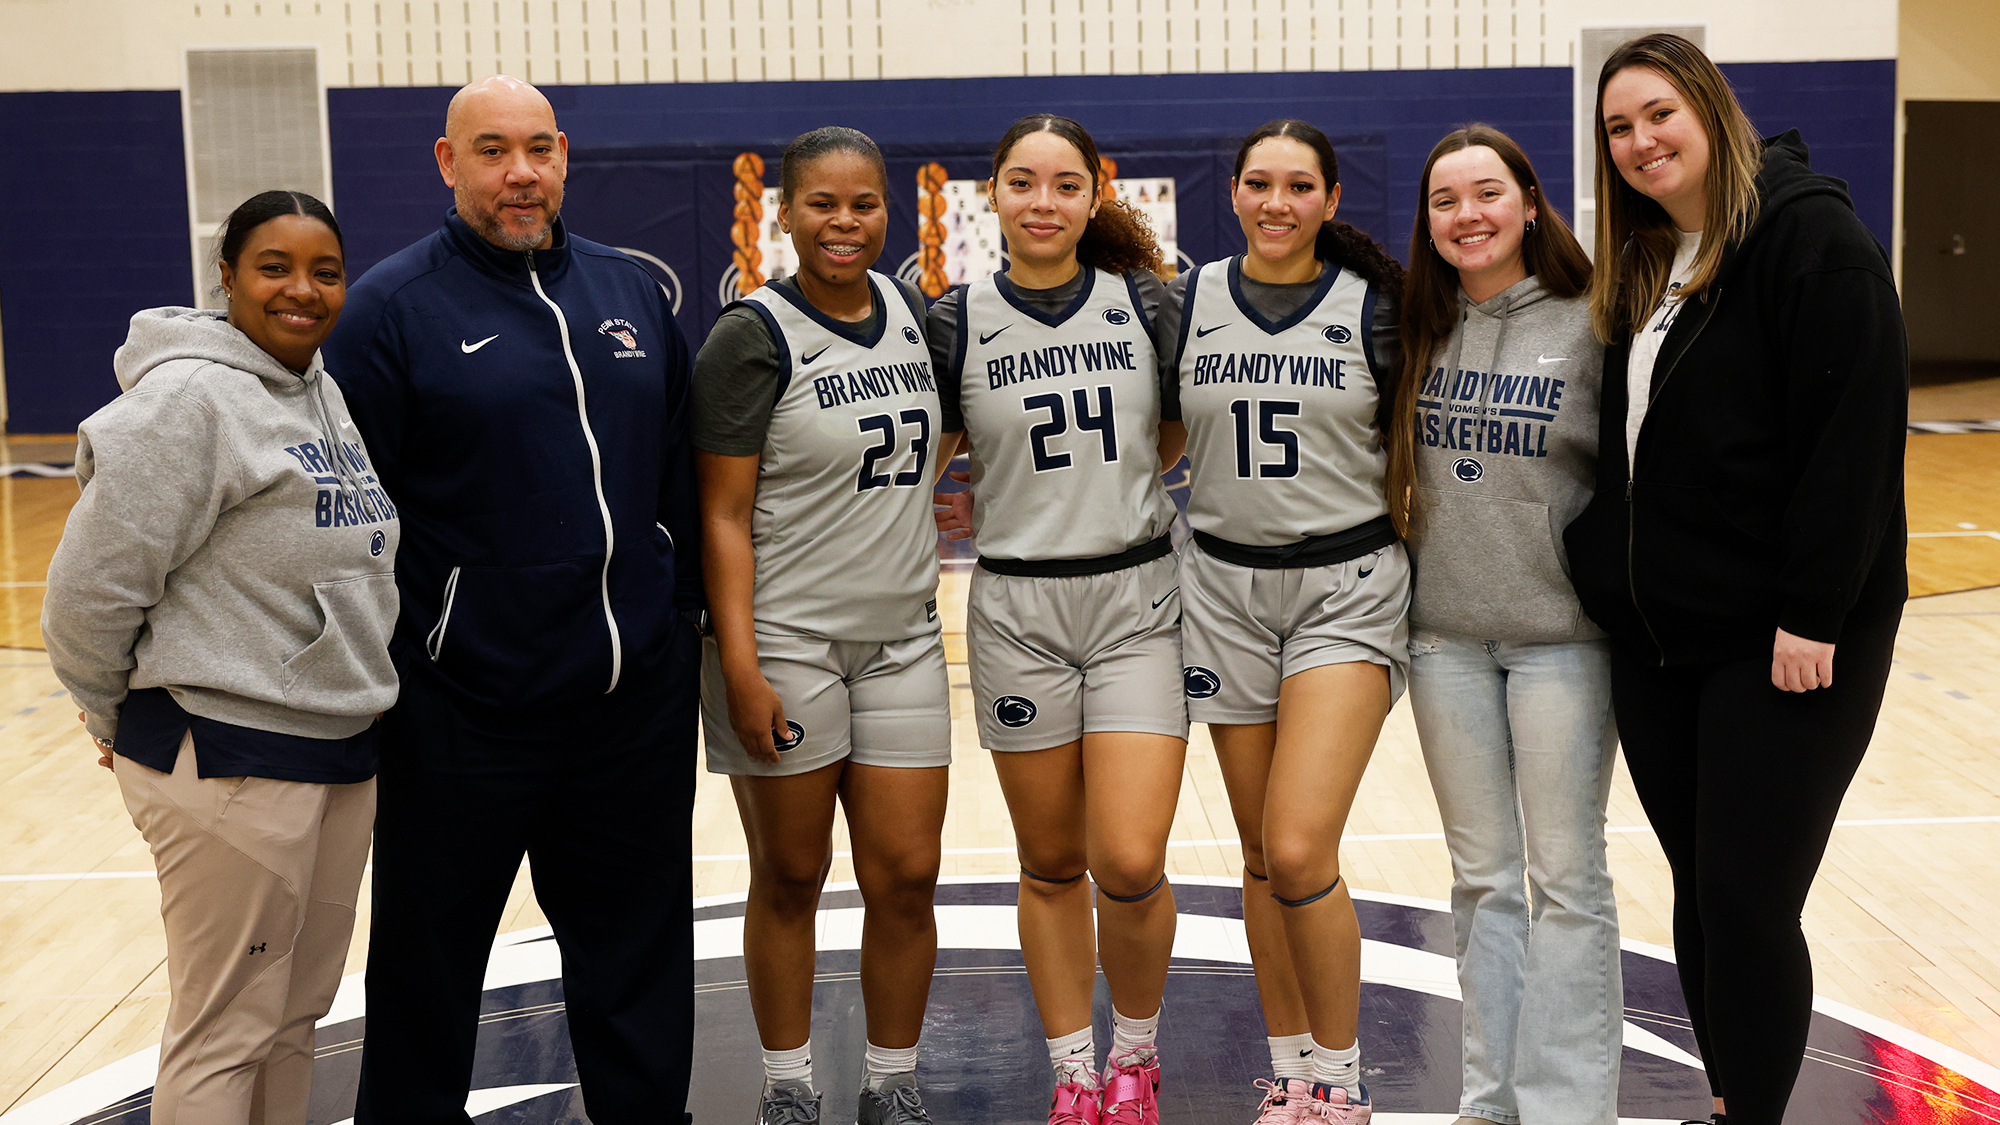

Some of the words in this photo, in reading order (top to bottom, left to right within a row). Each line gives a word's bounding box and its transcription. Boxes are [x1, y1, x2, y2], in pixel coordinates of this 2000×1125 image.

[921, 163, 948, 294] KIARA
[598, 318, 615, 335] PENN
[813, 361, 936, 410] BRANDYWINE
[986, 341, 1137, 391] BRANDYWINE
[1193, 352, 1347, 391] BRANDYWINE
[1418, 365, 1565, 412] RANDYWINE
[855, 406, 931, 495] 23
[1020, 384, 1121, 474] 24
[1228, 397, 1303, 481] 15
[1414, 412, 1548, 458] ASKETBALL
